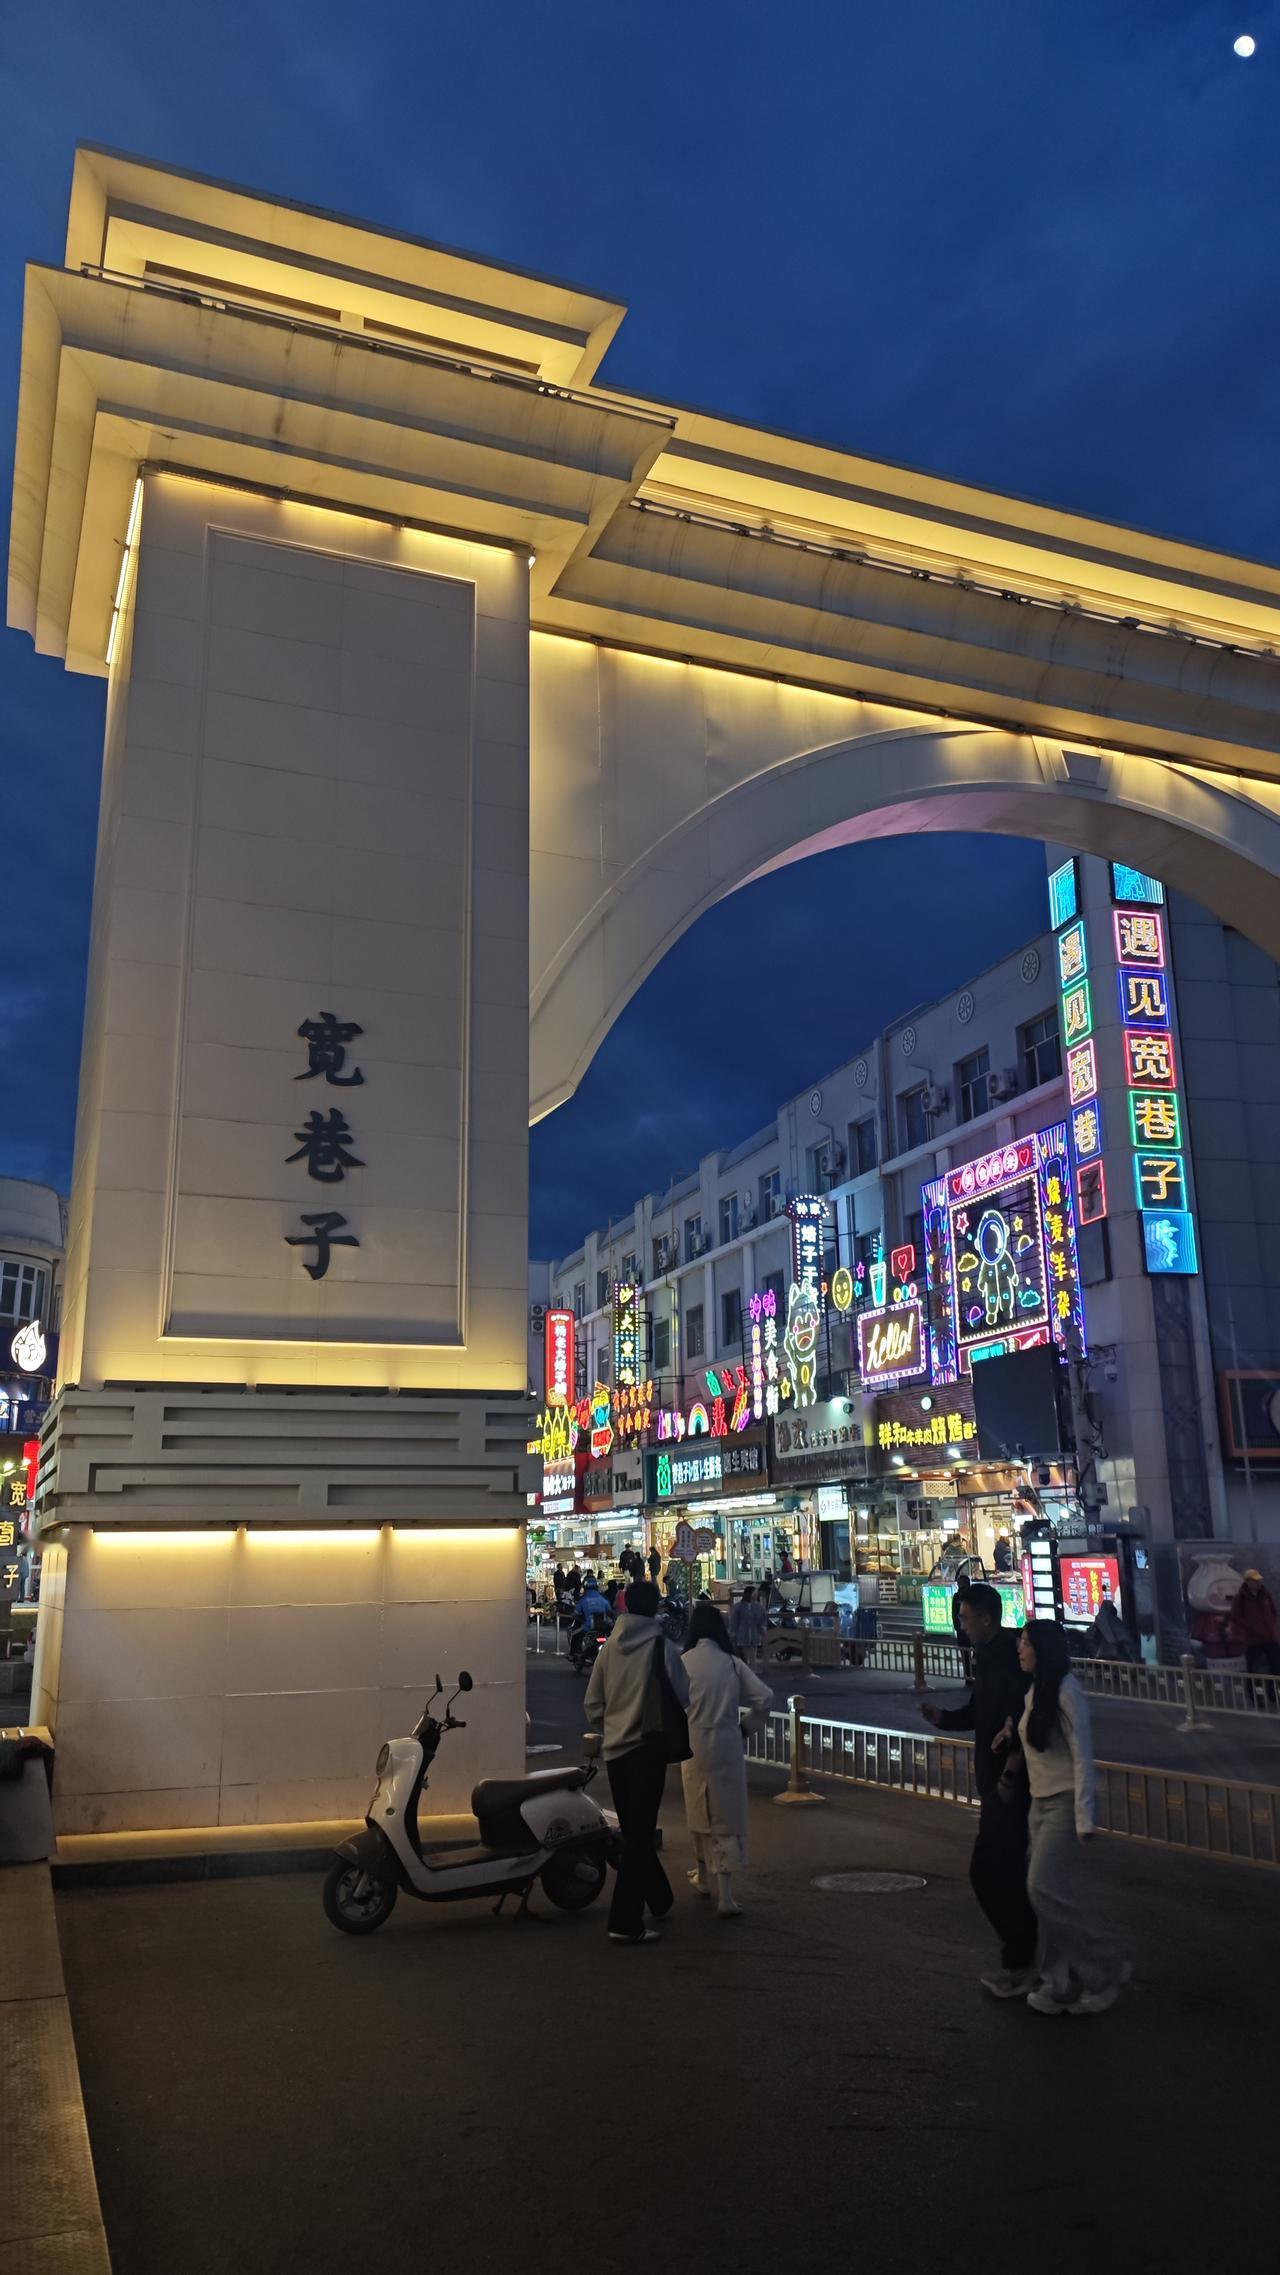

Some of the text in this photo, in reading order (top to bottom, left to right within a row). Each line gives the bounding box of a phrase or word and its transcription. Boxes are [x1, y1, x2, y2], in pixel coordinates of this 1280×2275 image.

[285, 1011, 366, 1280] 宽巷子
[1061, 932, 1102, 1215] 遇见宽巷子
[1120, 916, 1182, 1201] 遇见宽巷子
[866, 1313, 915, 1371] hello!
[1047, 1177, 1070, 1319] 烧麦羊杂
[764, 1319, 779, 1416] 美食街
